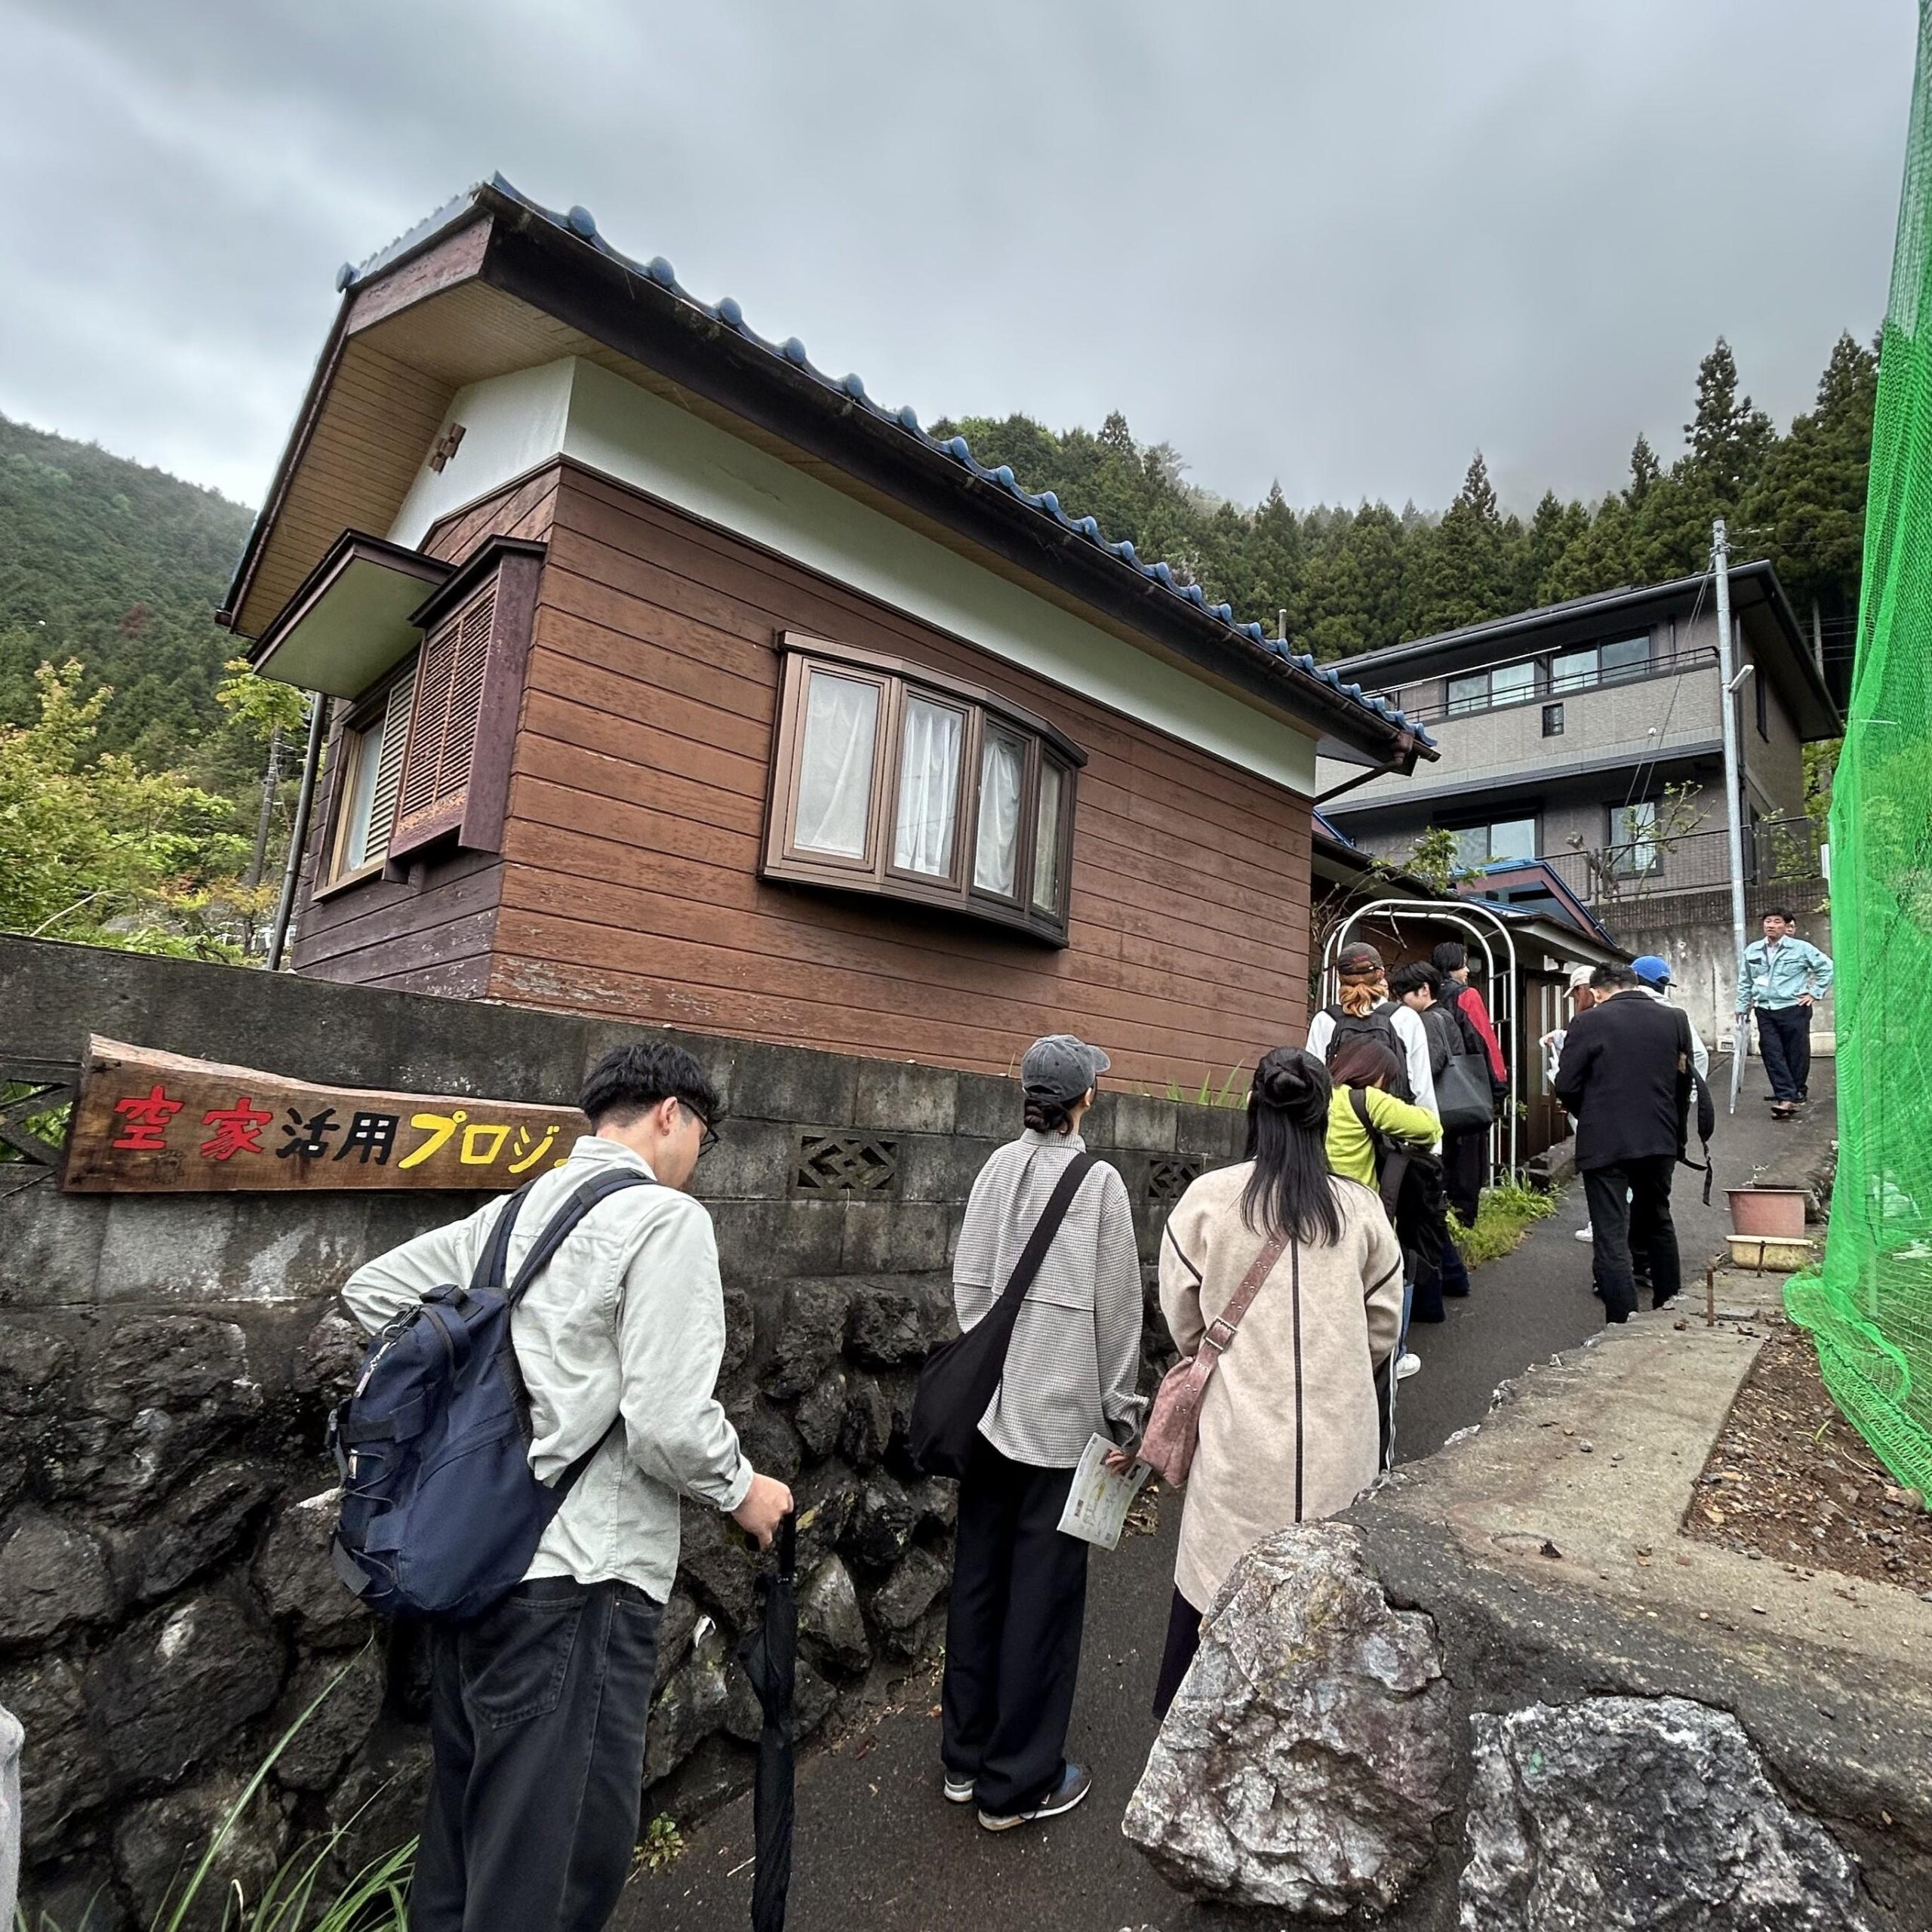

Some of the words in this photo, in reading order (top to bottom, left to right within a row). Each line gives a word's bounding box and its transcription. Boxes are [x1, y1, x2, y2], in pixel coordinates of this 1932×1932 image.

[113, 1084, 569, 1173] 空家活用プロジ
